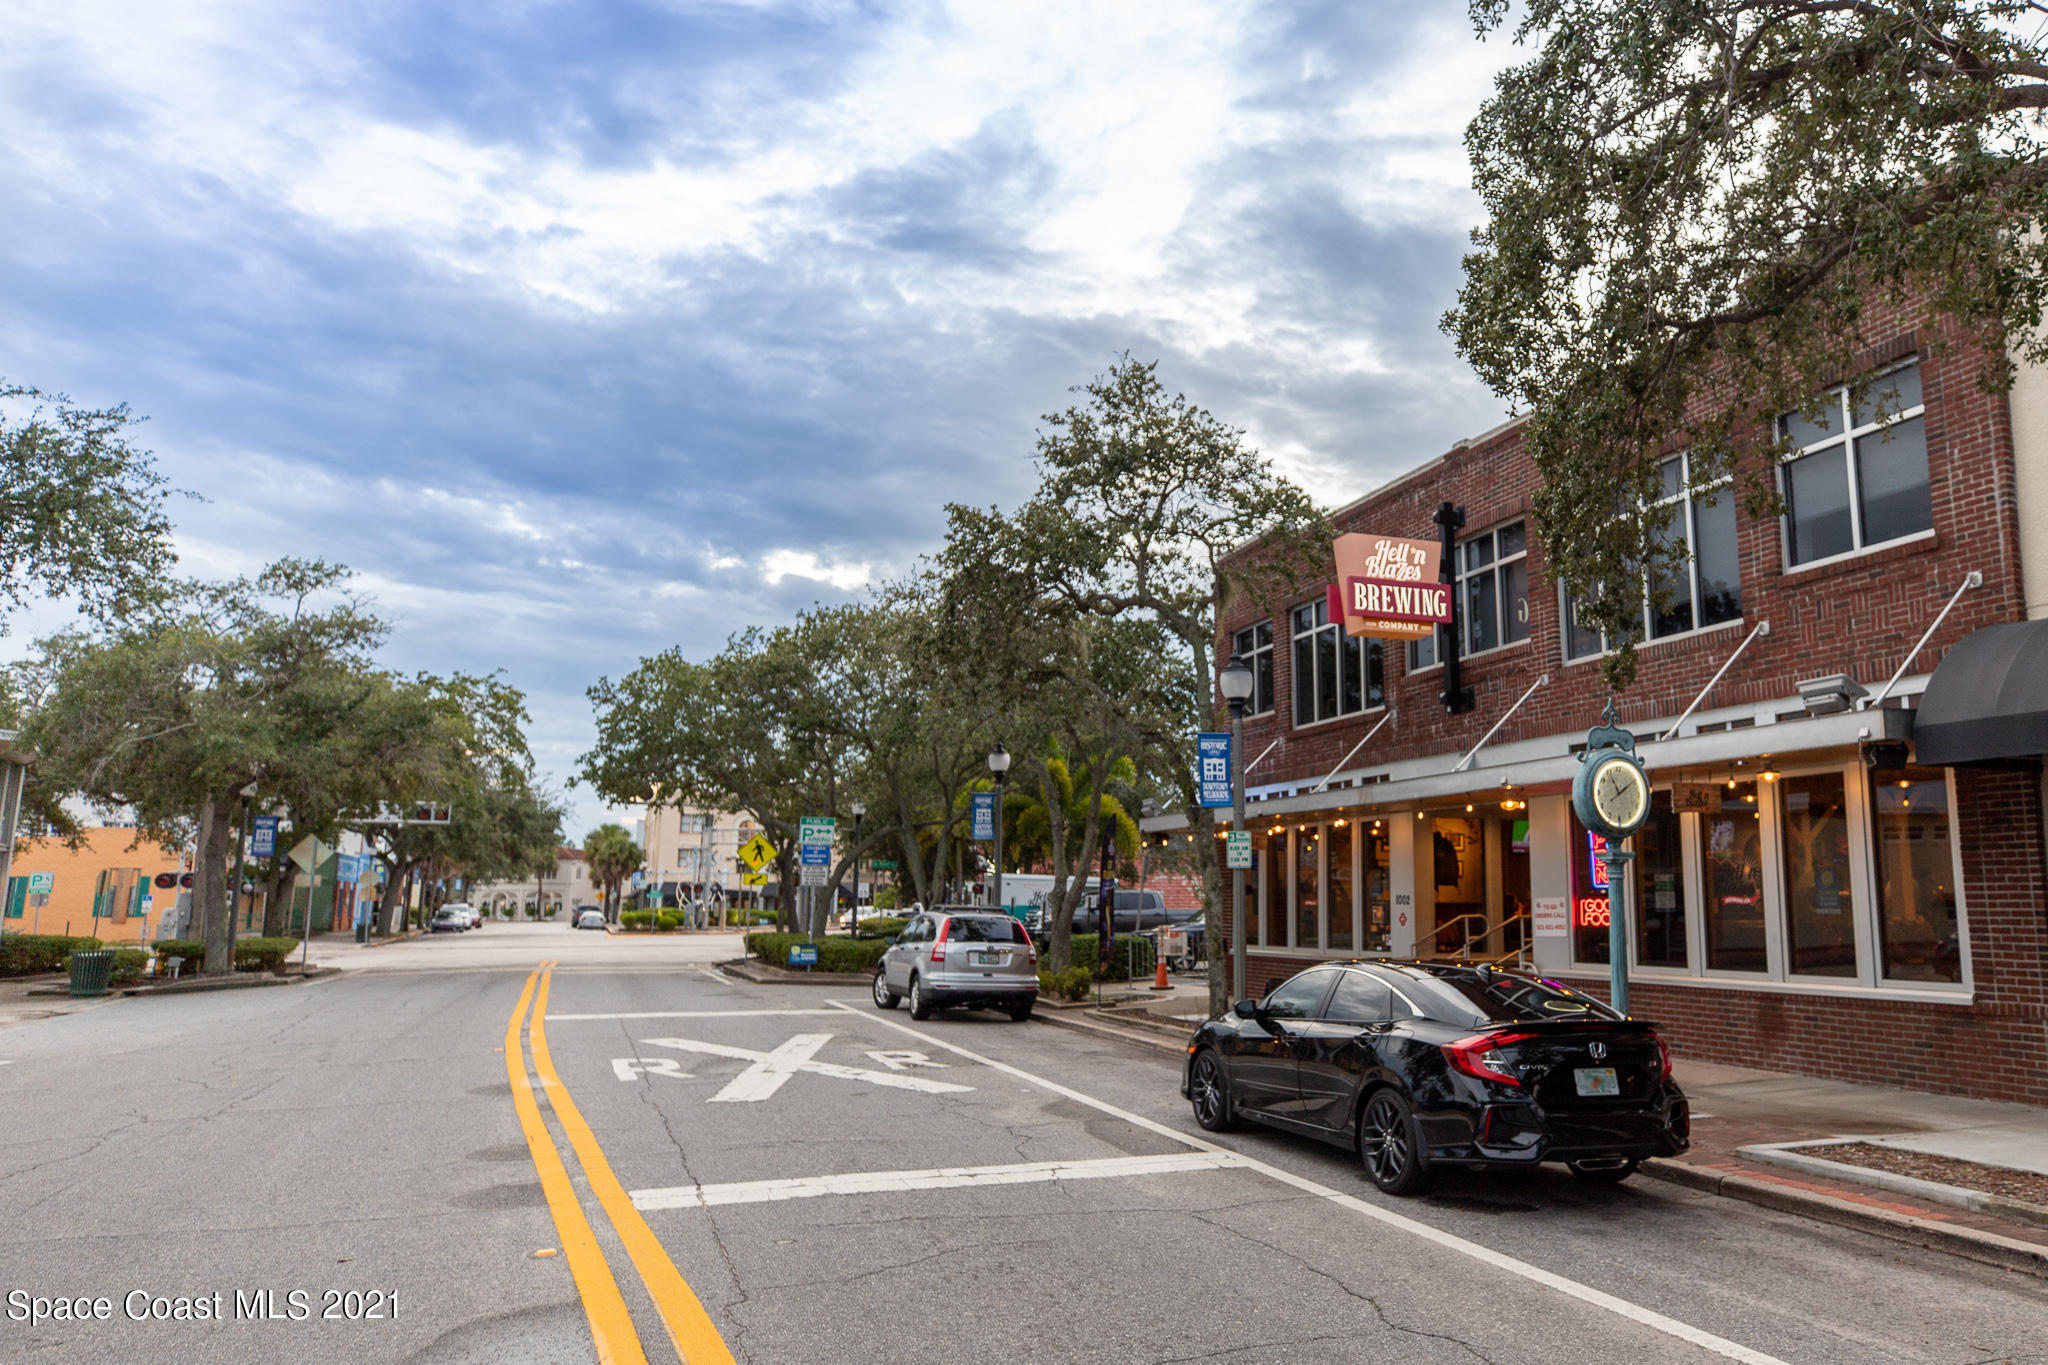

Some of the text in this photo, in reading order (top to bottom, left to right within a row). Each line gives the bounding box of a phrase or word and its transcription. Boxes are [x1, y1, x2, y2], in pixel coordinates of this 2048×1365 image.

[1364, 555, 1421, 582] Blazes
[1353, 582, 1447, 618] BREWING
[1378, 620, 1419, 632] COMPANY
[1201, 741, 1227, 750] HISTORIC
[802, 828, 831, 842] PARKING
[1395, 894, 1410, 905] 1002
